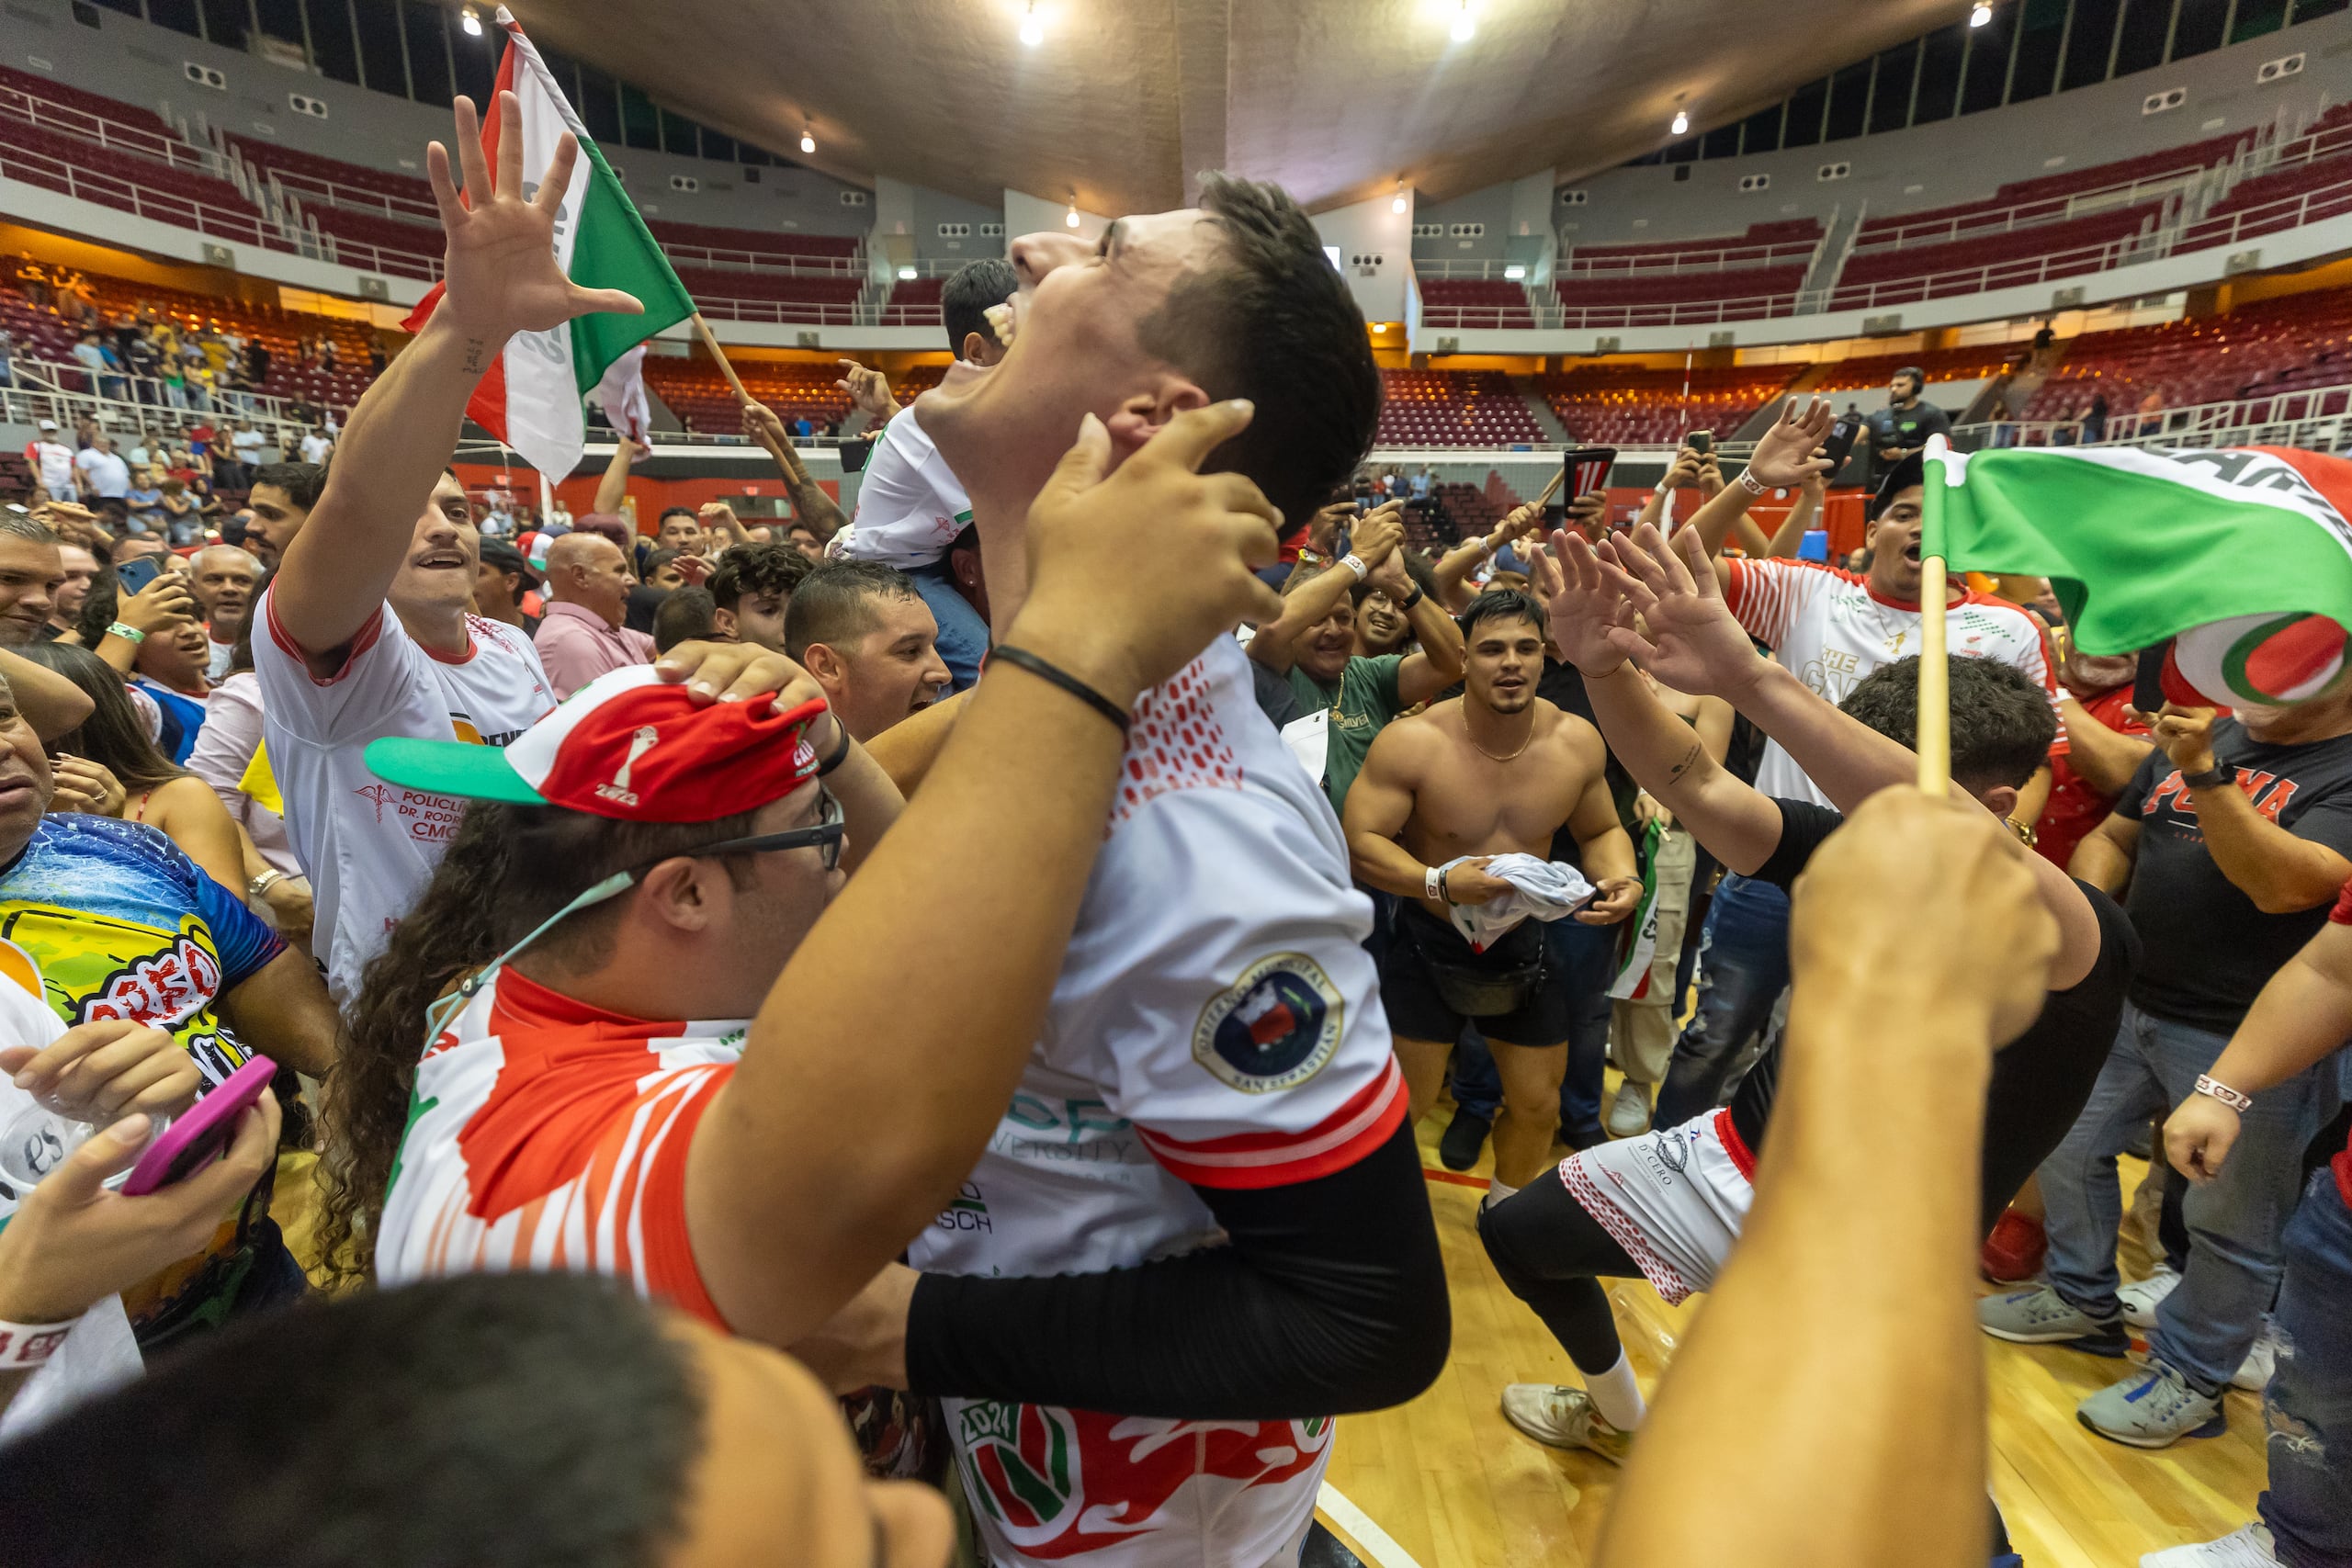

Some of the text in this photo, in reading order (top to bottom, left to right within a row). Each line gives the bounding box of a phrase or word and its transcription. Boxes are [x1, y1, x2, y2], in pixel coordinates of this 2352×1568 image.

[398, 805, 462, 826] DR. RODR
[993, 1131, 1134, 1163] VERSITY
[939, 1209, 993, 1235] SCH
[958, 1401, 1011, 1444] 2024
